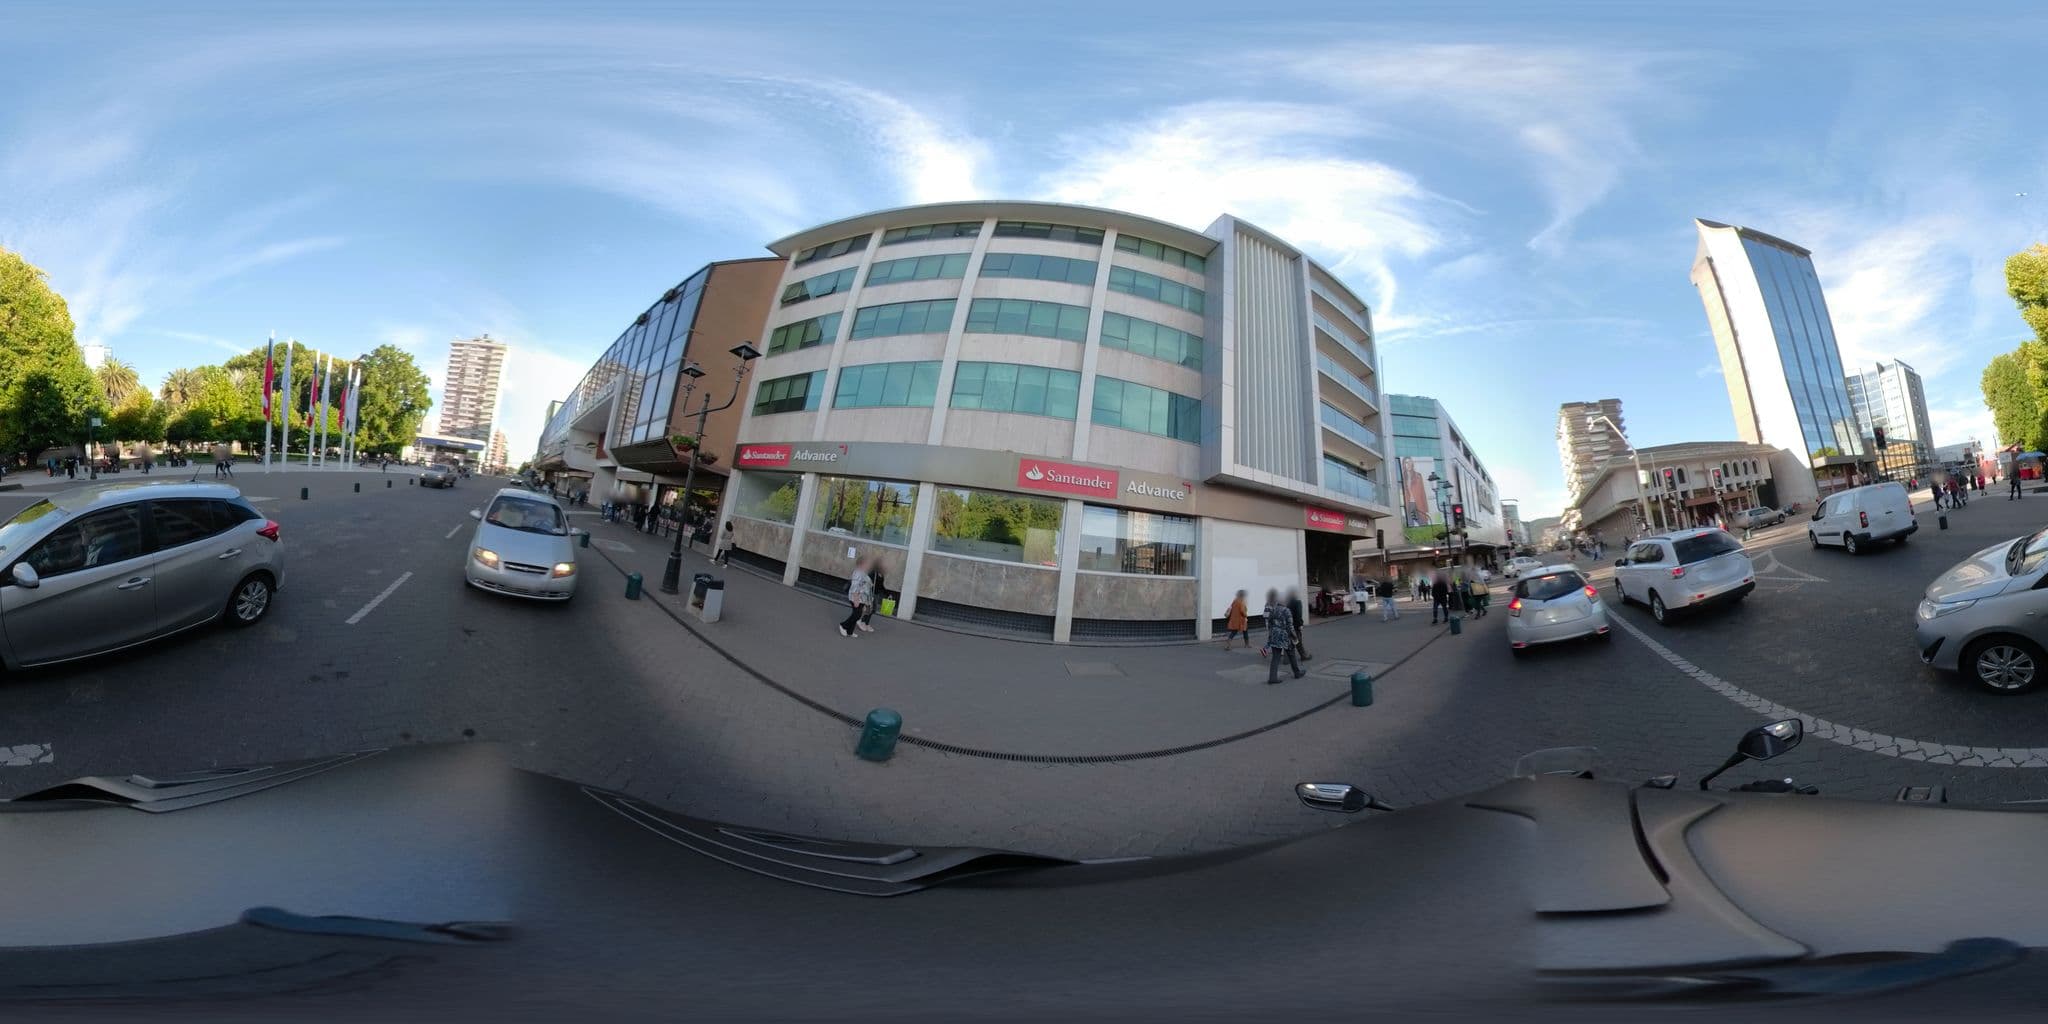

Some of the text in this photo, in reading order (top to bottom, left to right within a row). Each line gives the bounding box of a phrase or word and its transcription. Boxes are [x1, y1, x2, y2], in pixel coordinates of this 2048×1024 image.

[794, 450, 838, 461] Advance
[1046, 470, 1185, 501] Santander Advance
